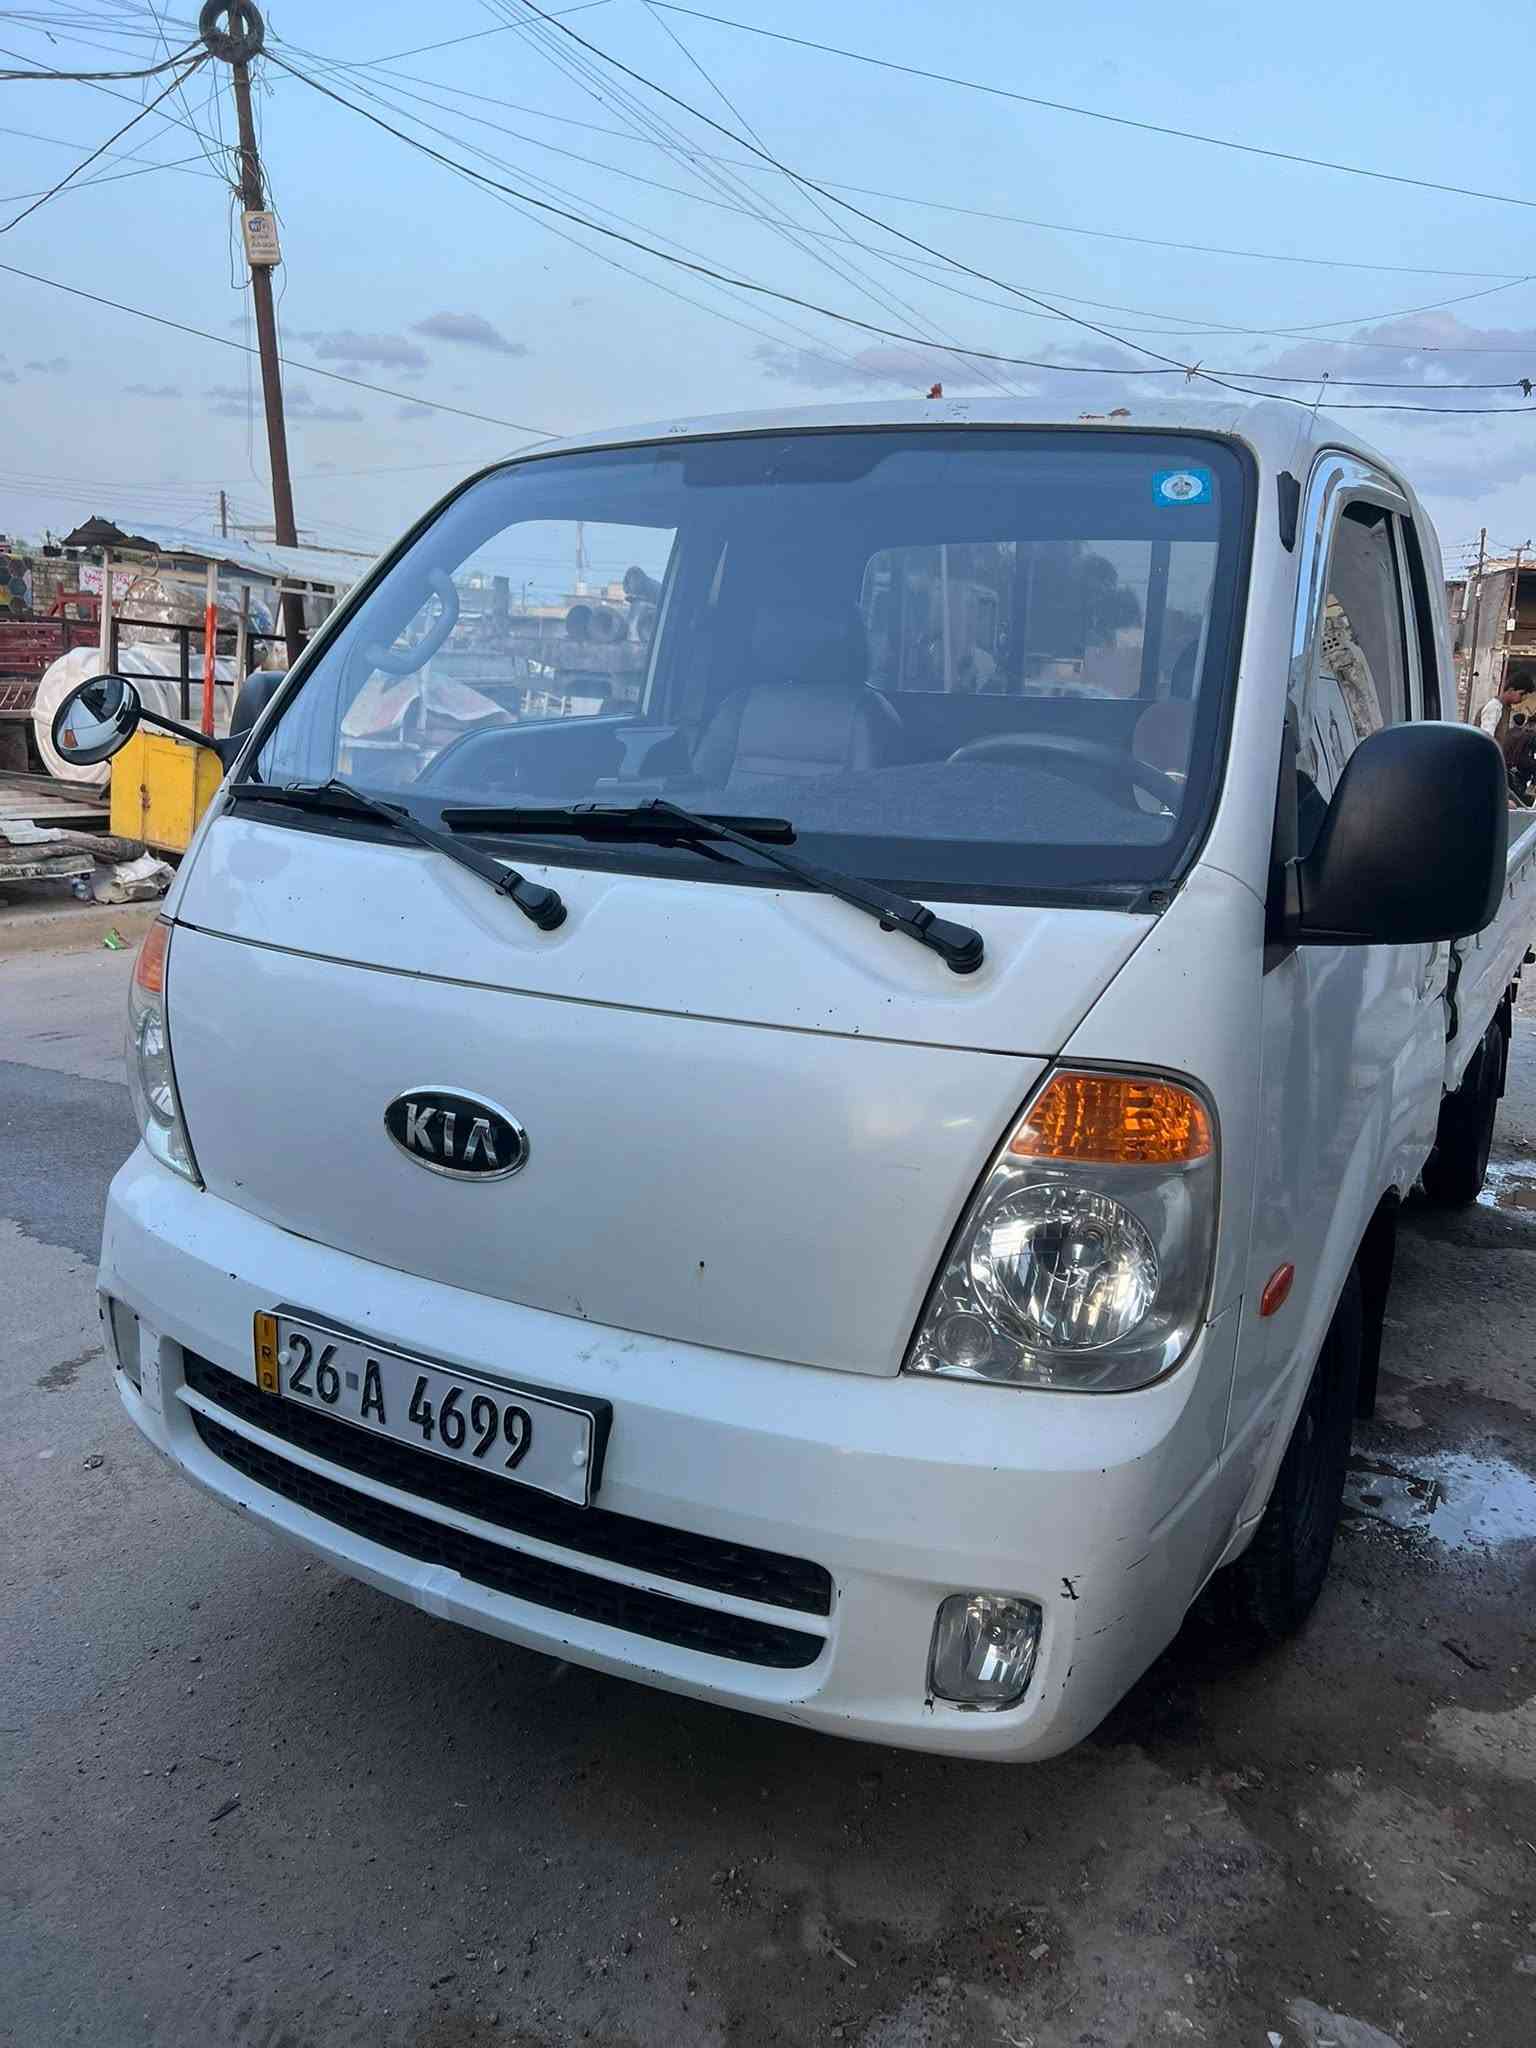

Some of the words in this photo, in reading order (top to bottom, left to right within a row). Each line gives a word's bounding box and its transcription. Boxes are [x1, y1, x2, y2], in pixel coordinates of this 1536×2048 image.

[405, 1102, 498, 1168] KIA
[287, 1332, 341, 1403] 26
[360, 1357, 387, 1425] A
[408, 1375, 533, 1470] 4699
